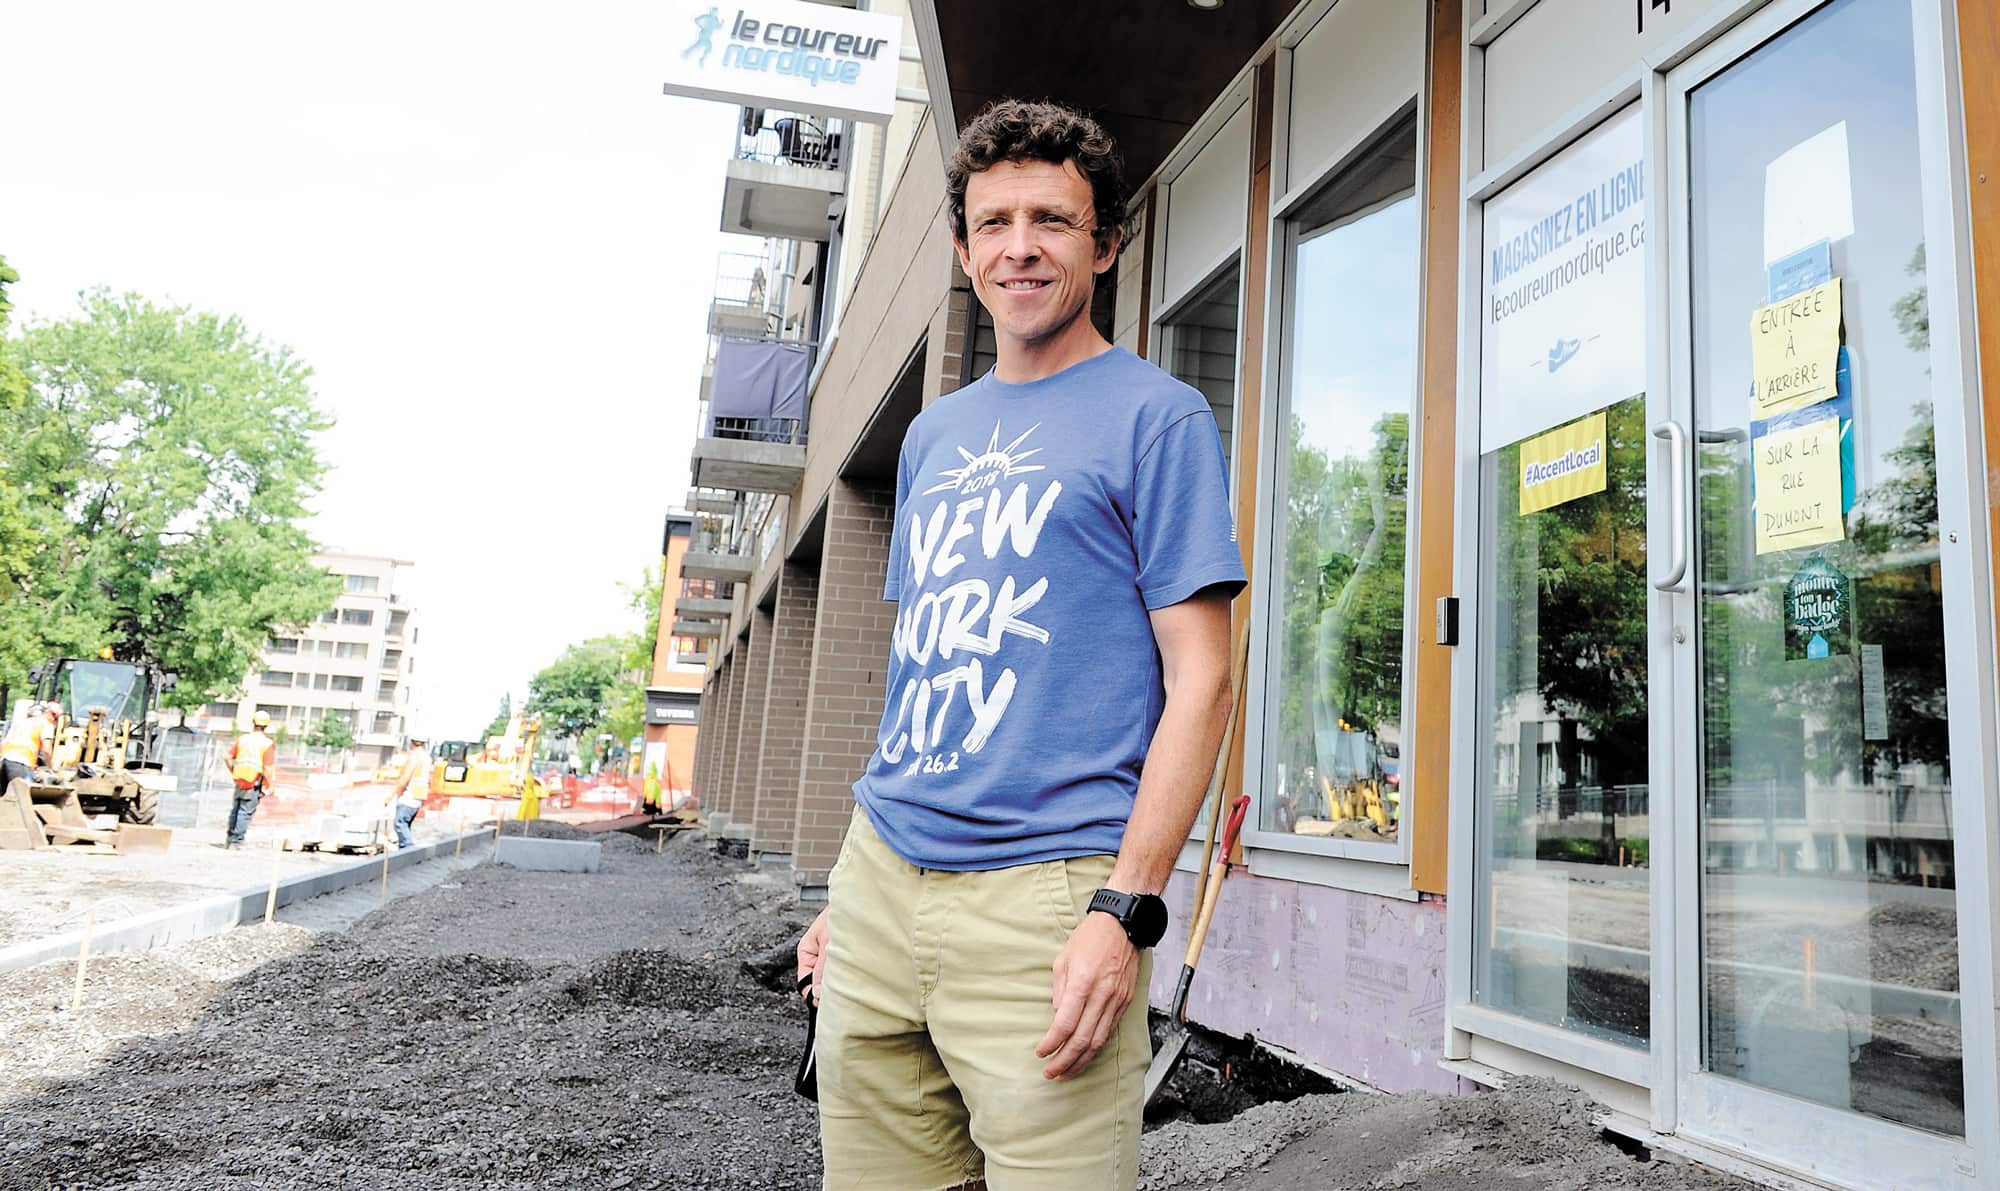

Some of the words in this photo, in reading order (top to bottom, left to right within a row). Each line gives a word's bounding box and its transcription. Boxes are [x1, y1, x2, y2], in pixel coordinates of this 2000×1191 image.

[730, 10, 760, 41] le
[763, 22, 888, 61] coureur
[722, 43, 861, 87] nordique
[1492, 203, 1573, 286] MAGASINEZ
[1576, 189, 1597, 236] EN
[1760, 288, 1824, 334] ENTRÉE
[1785, 330, 1796, 358] À
[1757, 363, 1819, 402] L'ARRIÈRE
[1526, 442, 1600, 486] #AccentLocal
[1766, 440, 1793, 465] SUR
[1802, 435, 1820, 458] LA
[1781, 472, 1805, 494] RUE
[1763, 502, 1822, 532] DUMONT
[908, 480, 1063, 588] NEW
[1794, 577, 1839, 597] montre
[1800, 594, 1814, 604] ton
[1793, 594, 1840, 622] badge
[923, 752, 959, 774] 26.2
